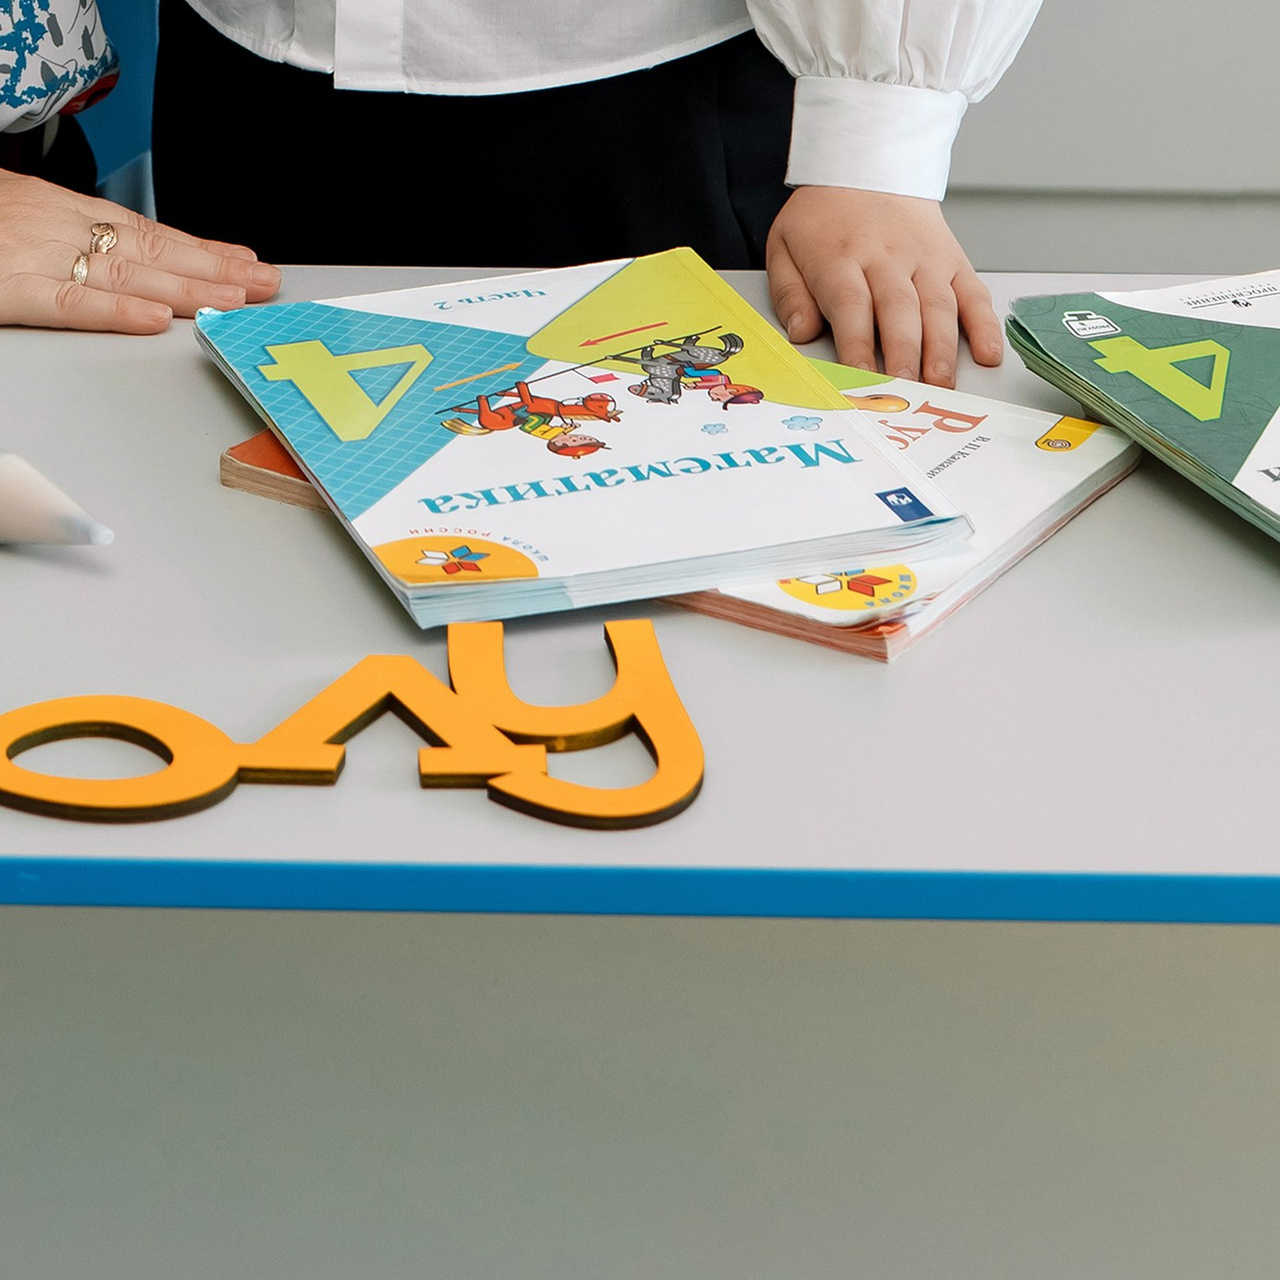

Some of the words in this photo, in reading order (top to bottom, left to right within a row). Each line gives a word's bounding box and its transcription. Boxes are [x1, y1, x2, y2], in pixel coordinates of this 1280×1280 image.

[433, 301, 453, 312] 2
[457, 289, 547, 305] Часть
[258, 340, 434, 442] 4
[1088, 336, 1230, 422] 4
[417, 438, 863, 515] Математика
[408, 527, 492, 538] РОССИИ
[501, 535, 550, 562] ШКОЛА
[865, 574, 912, 607] ШКОЛА
